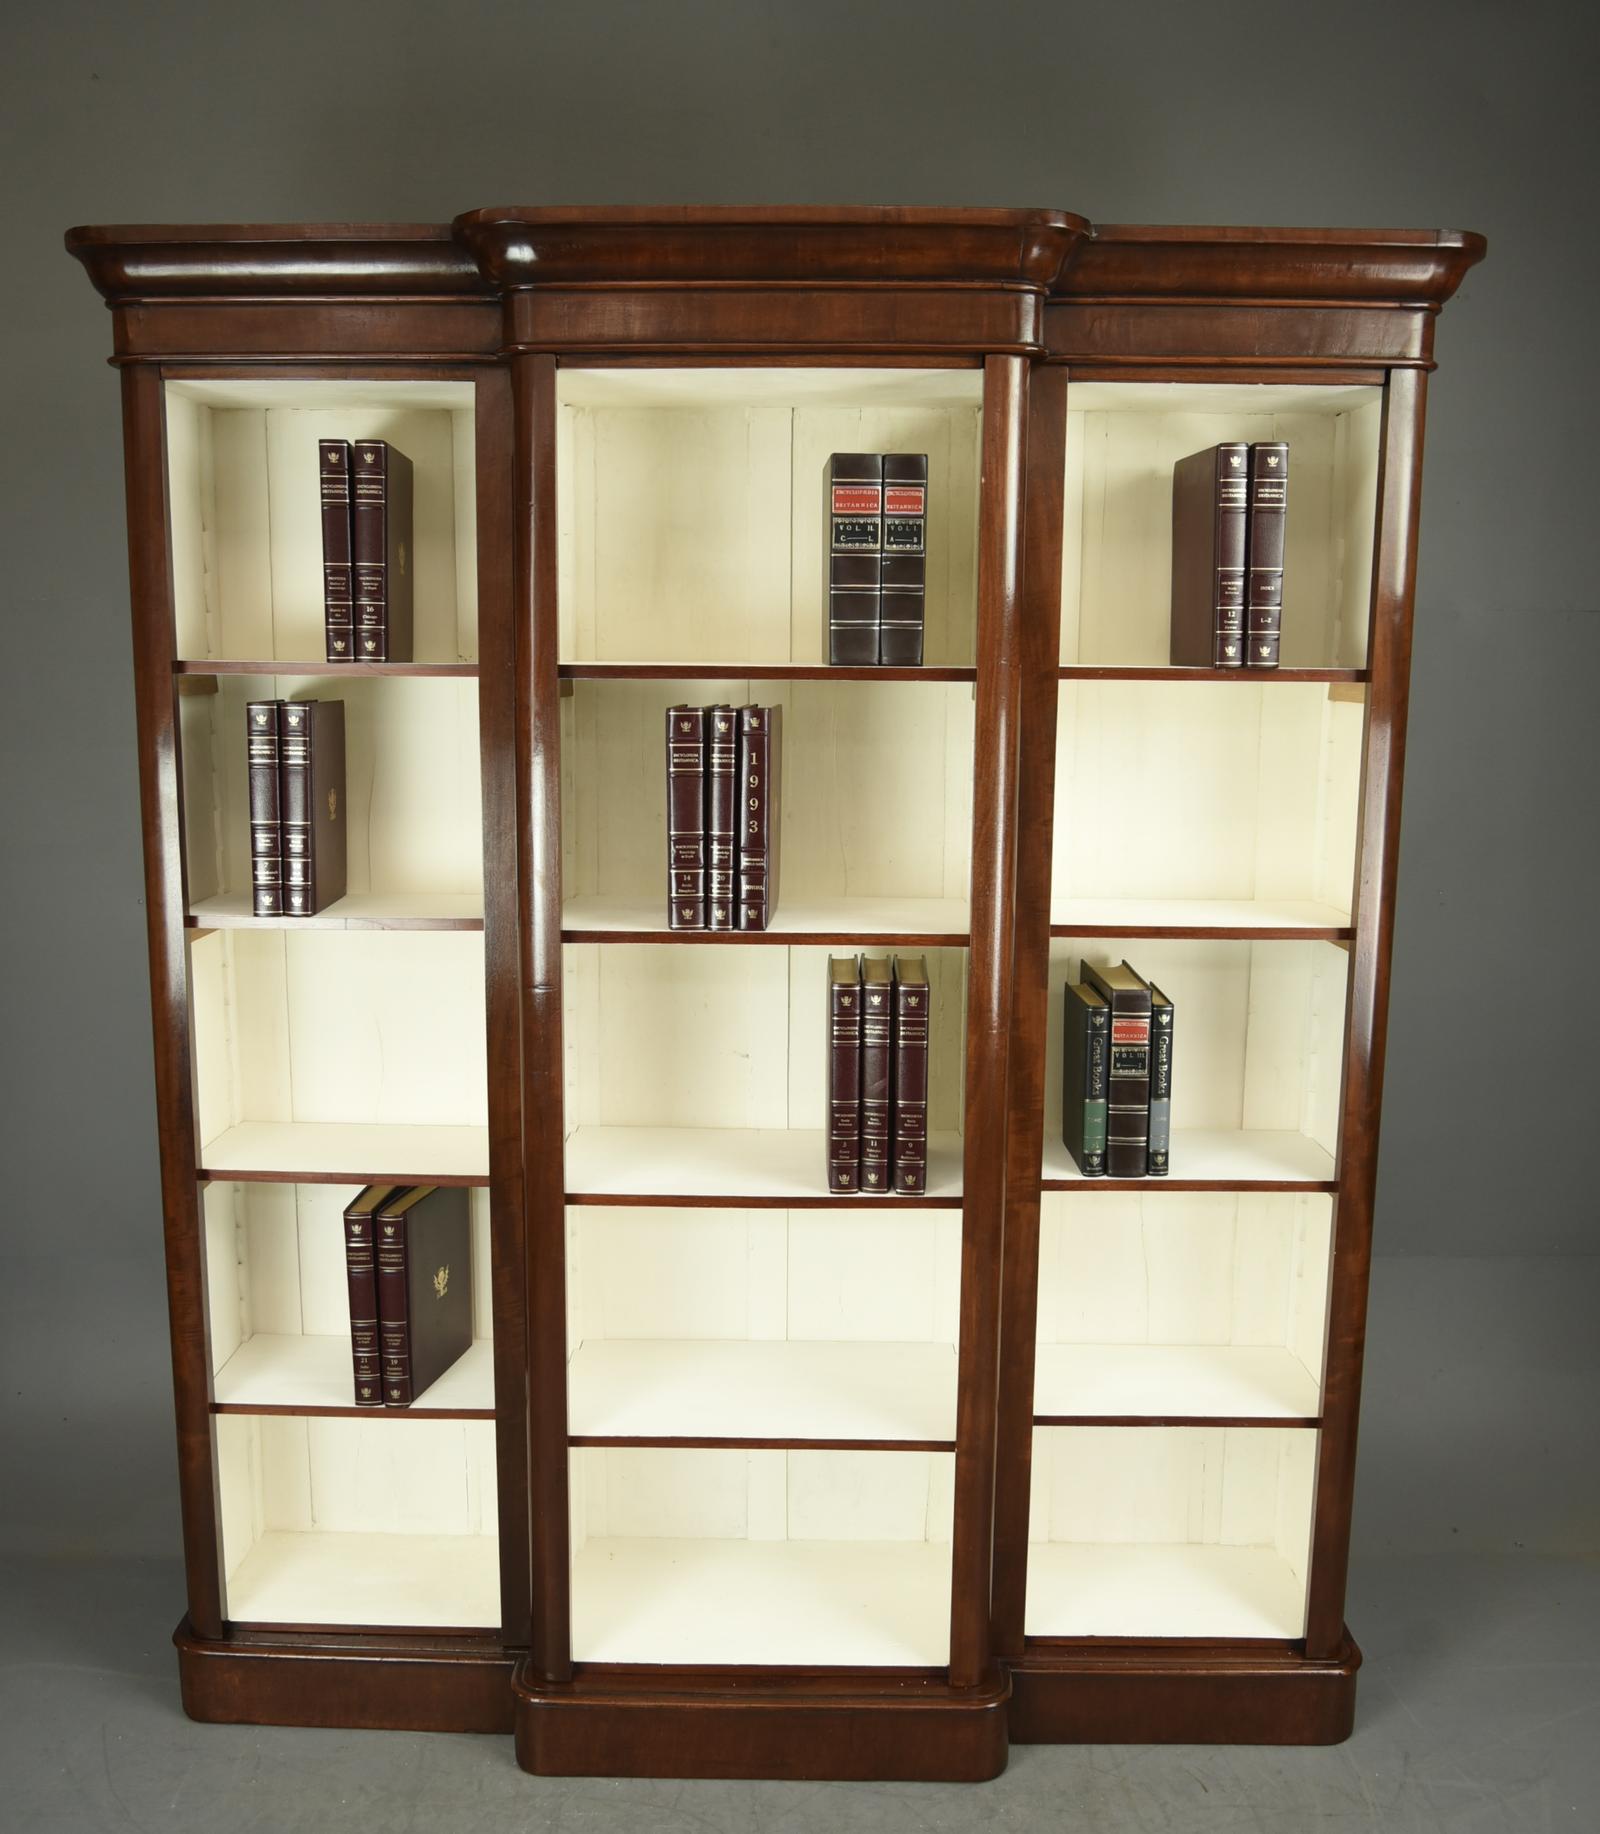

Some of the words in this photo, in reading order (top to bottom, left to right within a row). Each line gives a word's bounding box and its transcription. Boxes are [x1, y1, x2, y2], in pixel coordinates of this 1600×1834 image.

[839, 524, 862, 532] VOL
[366, 605, 375, 613] 16
[749, 752, 759, 833] 1993
[1093, 1037, 1102, 1064] Great
[1159, 1036, 1169, 1062] Great
[1092, 1066, 1102, 1096] Books
[1158, 1064, 1168, 1094] Books
